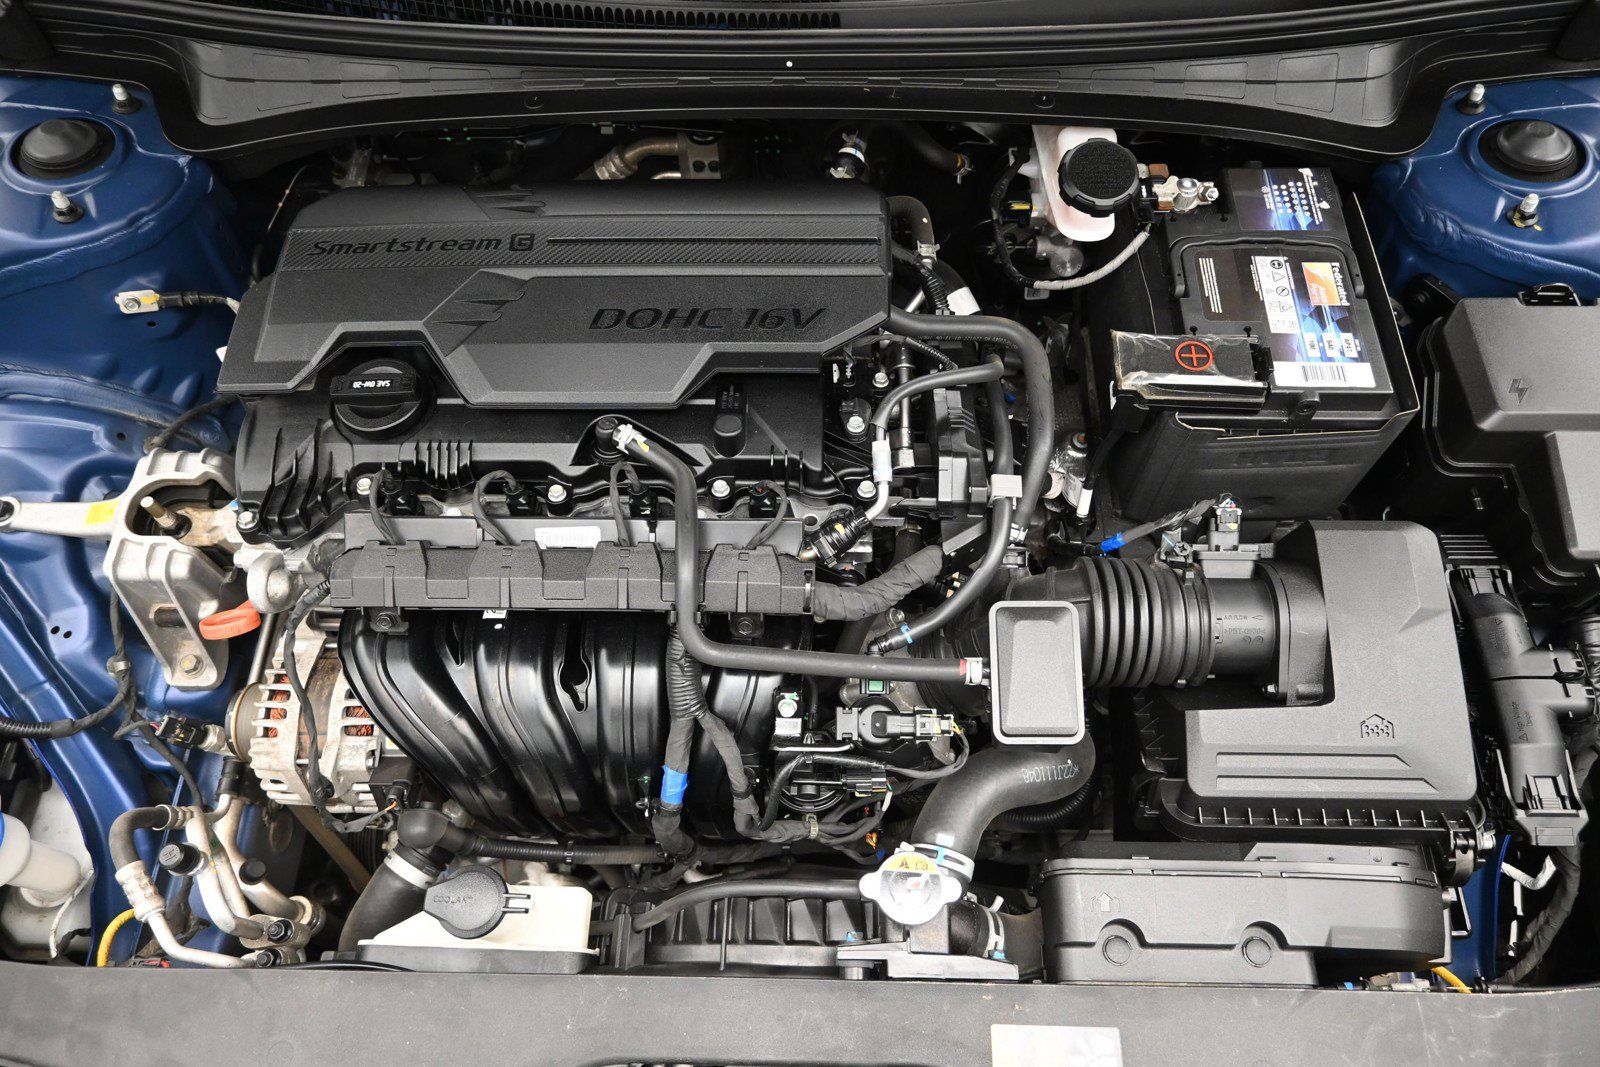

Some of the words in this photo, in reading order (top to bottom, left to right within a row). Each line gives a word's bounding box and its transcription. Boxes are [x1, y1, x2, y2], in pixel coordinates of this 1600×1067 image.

[308, 237, 502, 256] Smartstream
[588, 308, 733, 329] DOHC
[743, 308, 827, 329] 16V
[352, 380, 376, 389] 0W-20
[376, 380, 391, 388] SAE
